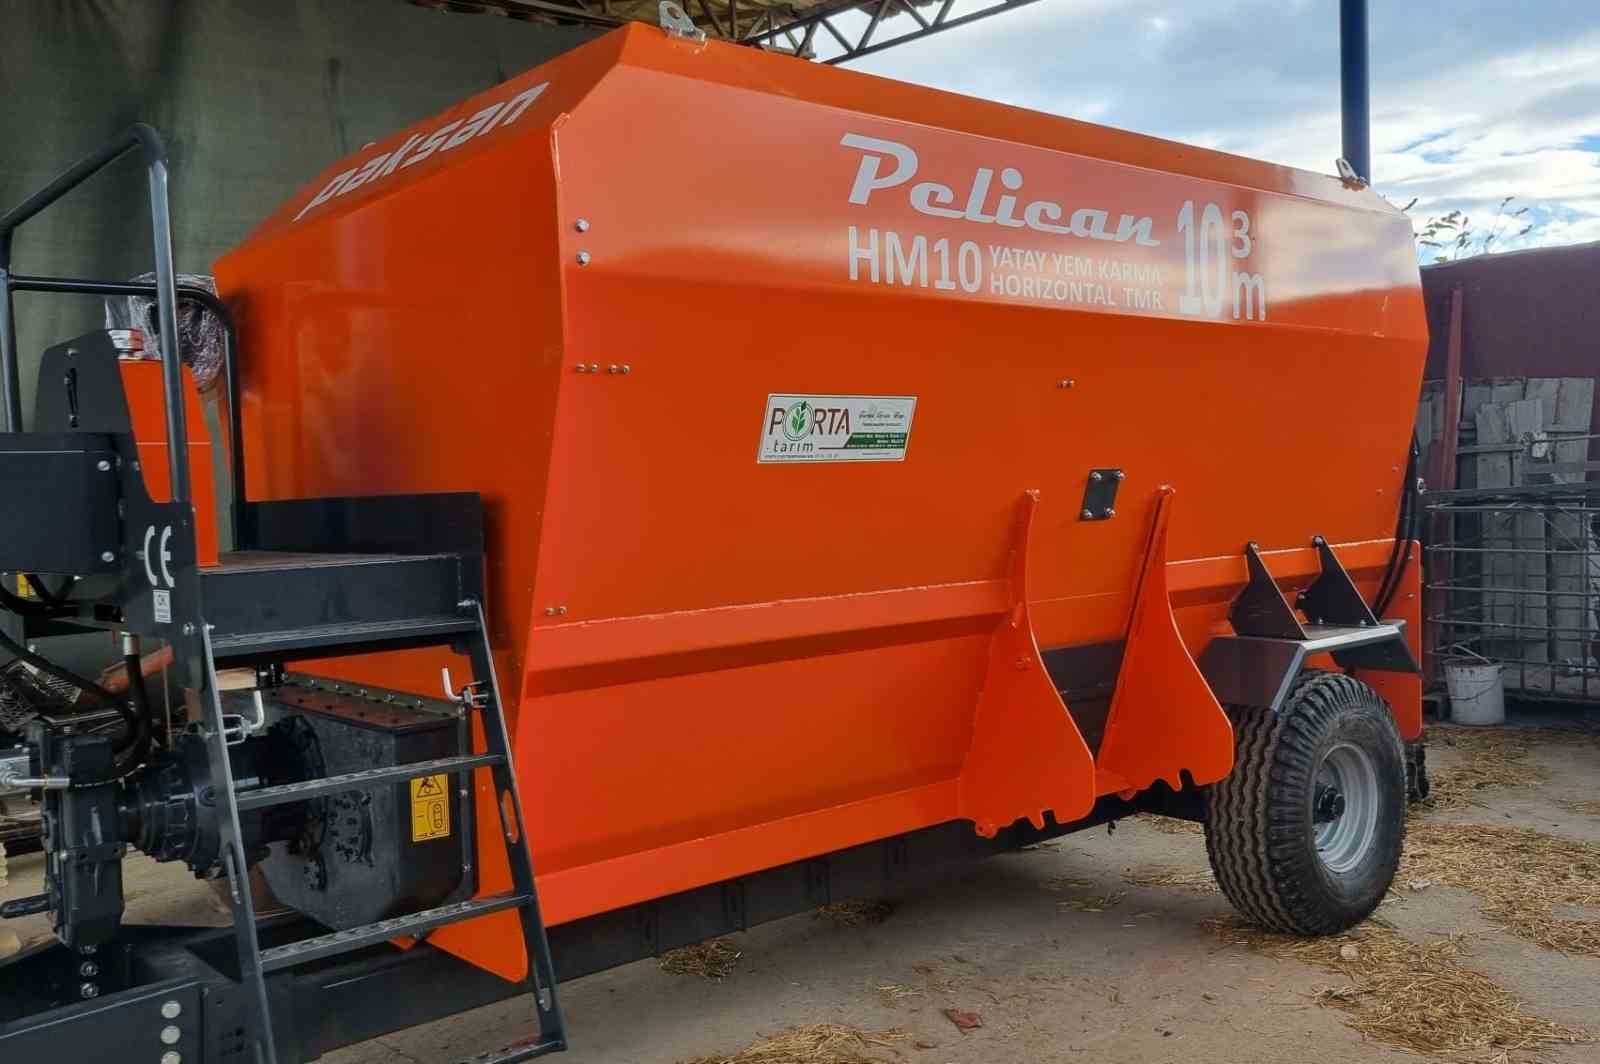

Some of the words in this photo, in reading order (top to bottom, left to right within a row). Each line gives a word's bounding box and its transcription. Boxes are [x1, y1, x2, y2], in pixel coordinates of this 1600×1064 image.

[292, 81, 549, 222] paksan
[840, 133, 1161, 247] Pelican
[848, 225, 982, 294] HM10
[989, 245, 1047, 272] YATAY
[1052, 252, 1098, 277] YEM
[1099, 257, 1163, 285] KARMA
[1177, 200, 1226, 318] 10
[989, 276, 1116, 306] HORIZONTAL
[1122, 285, 1163, 311] TMR
[1231, 270, 1266, 321] m
[144, 525, 175, 588] CE
